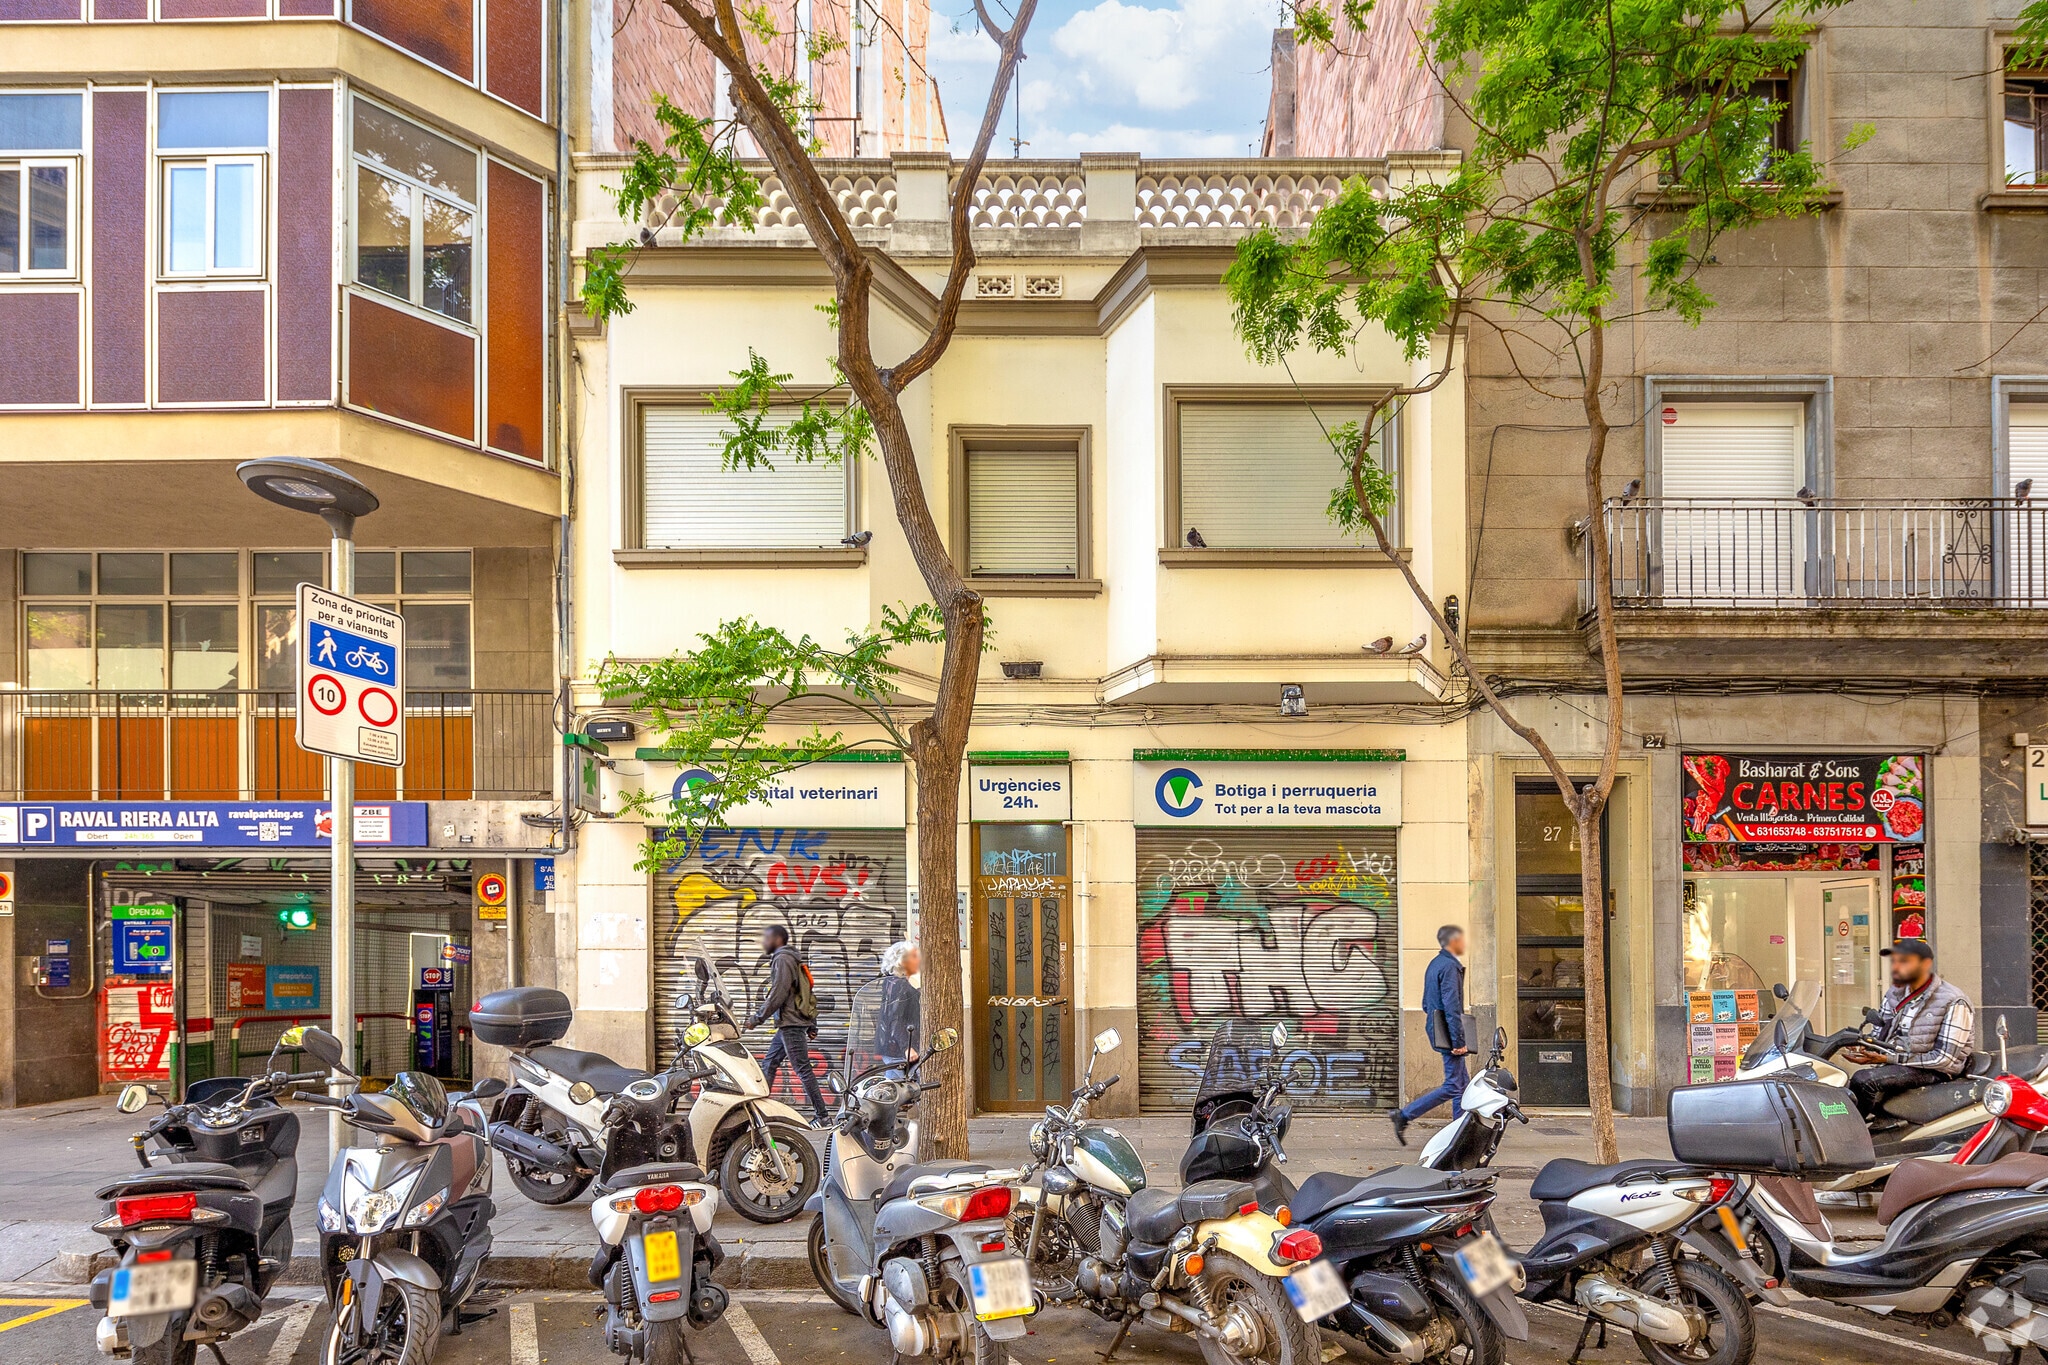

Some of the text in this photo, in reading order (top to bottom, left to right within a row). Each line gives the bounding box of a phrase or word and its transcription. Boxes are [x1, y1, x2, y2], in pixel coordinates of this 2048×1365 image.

[311, 592, 396, 629] Zona de prioritat
[318, 611, 389, 640] per a vianants
[318, 687, 335, 703] 10
[1645, 734, 1663, 748] 27
[2031, 749, 2048, 768] 2
[1739, 760, 1860, 780] Basharat & Sons
[799, 786, 878, 800] veterinari
[979, 778, 1061, 795] Urgències
[1215, 783, 1377, 800] Botiga i perruqueria
[1003, 795, 1039, 809] 24h.
[1731, 781, 1866, 811] CARNES
[228, 809, 304, 819] ravalparking.es
[1215, 803, 1382, 817] Tot per a la teva mascota
[27, 813, 48, 837] P
[59, 811, 219, 828] RAVAL RIERA ALTA
[1736, 813, 1759, 822] Venta
[1760, 813, 1798, 824] Mayorista
[1838, 813, 1865, 823] Calidad
[86, 832, 108, 840] Obert
[173, 833, 194, 841] Open
[1543, 826, 1562, 842] 27
[1756, 827, 1806, 836] 631653748
[1813, 827, 1863, 836] 637517512
[129, 907, 165, 916] OPEN 24h
[457, 947, 471, 955] TICKET
[646, 1172, 670, 1180] YAMAHA
